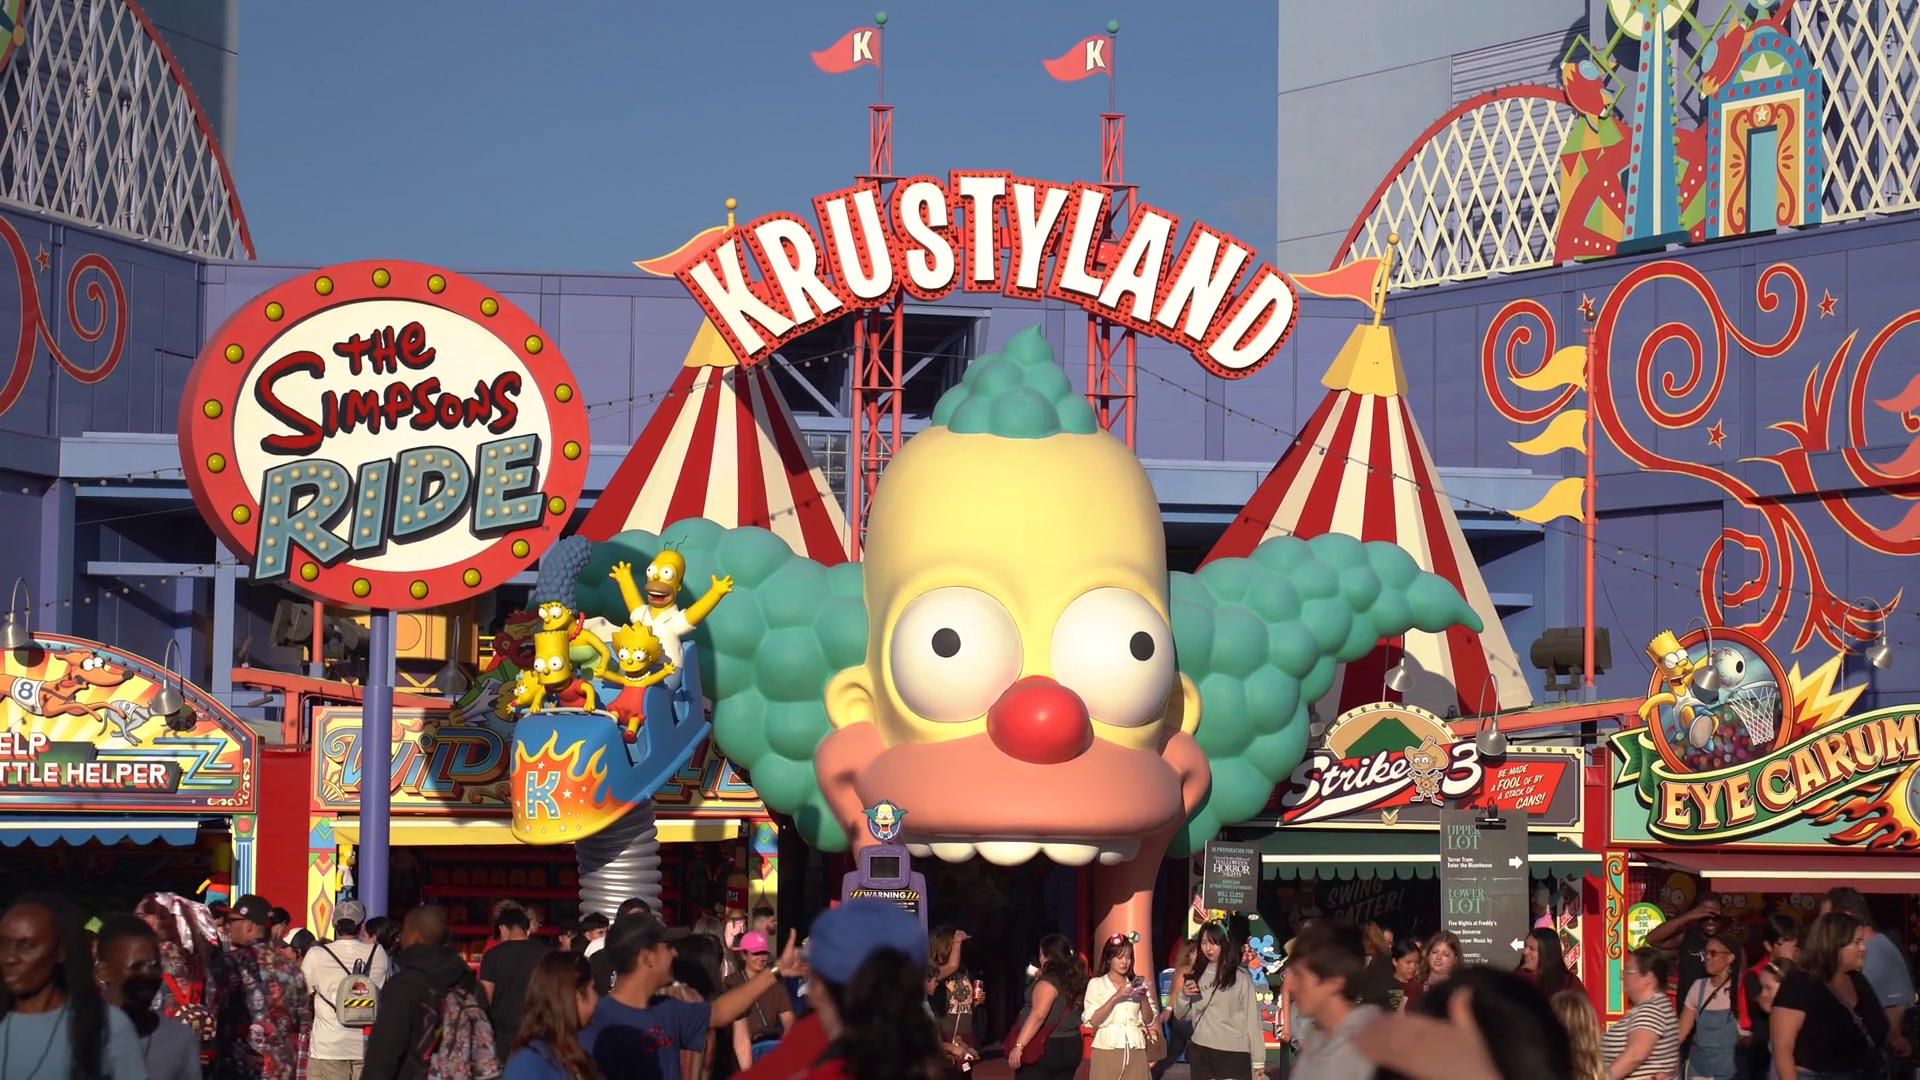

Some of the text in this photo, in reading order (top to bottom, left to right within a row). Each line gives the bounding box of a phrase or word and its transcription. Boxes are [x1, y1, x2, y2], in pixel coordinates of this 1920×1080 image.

[852, 30, 874, 64] K
[1085, 38, 1106, 71] K
[686, 174, 1298, 371] KRUSTYLAND
[250, 433, 546, 585] RIDE
[18, 681, 34, 700] 8
[124, 702, 131, 711] 9
[0, 732, 47, 756] ELP
[0, 762, 166, 784] TTLE HELPER
[1284, 743, 1483, 811] Strike 3
[1497, 764, 1528, 778] BE MADE
[1658, 712, 1920, 829] EYE CARUM
[1497, 776, 1521, 791] FOOL
[1523, 776, 1533, 785] OF
[1534, 774, 1544, 783] BY
[525, 770, 562, 820] K
[1497, 785, 1536, 801] A STACK OF
[1515, 792, 1546, 809] CANS!
[1447, 824, 1481, 836] UPPER
[1447, 835, 1481, 850] LOT
[1213, 863, 1250, 875] HORROR
[863, 891, 907, 899] WARNING
[1326, 876, 1383, 908] SWING
[1448, 888, 1484, 898] LOWER
[1449, 898, 1484, 914] LOT
